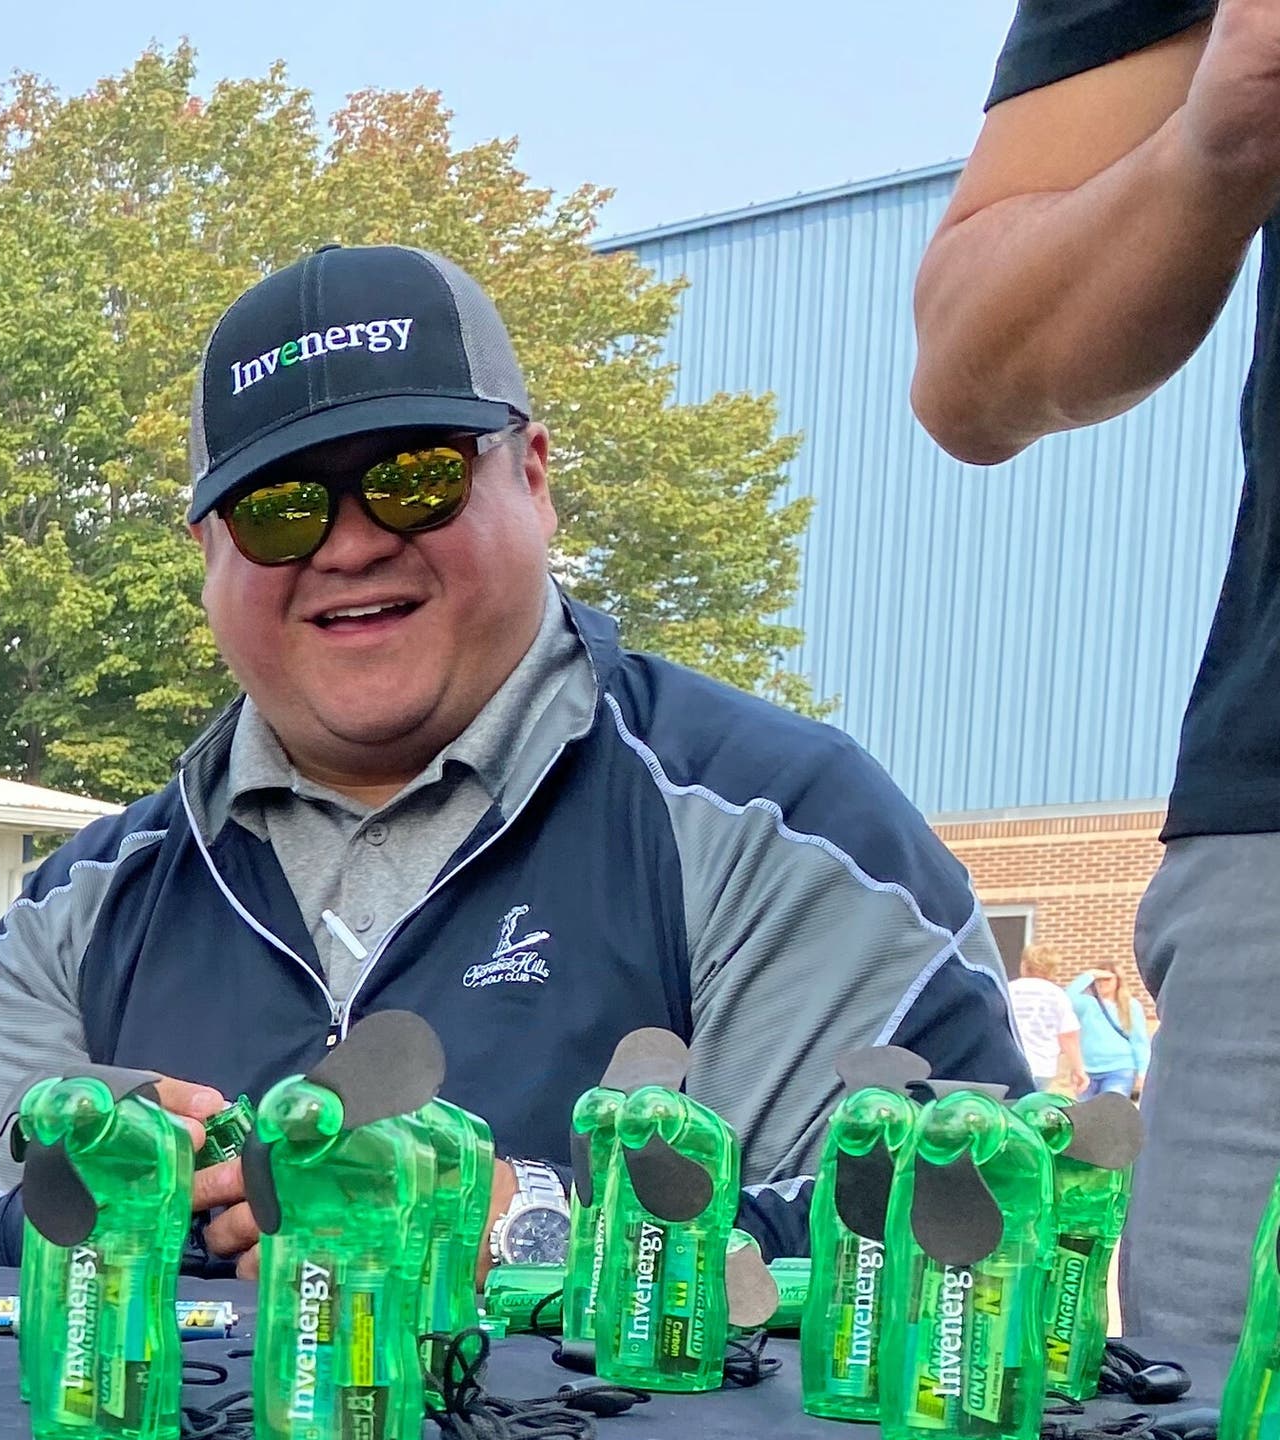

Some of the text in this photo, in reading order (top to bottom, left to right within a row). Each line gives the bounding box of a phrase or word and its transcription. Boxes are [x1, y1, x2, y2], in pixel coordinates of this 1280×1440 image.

[231, 318, 413, 396] Invenergy
[481, 972, 530, 986] GOLF CLUB
[512, 951, 551, 978] Hills
[60, 1246, 98, 1390] Invenergy
[627, 1220, 665, 1342] Invenergy
[845, 1237, 886, 1367] Invenergy
[932, 1265, 974, 1397] Invenerg
[1046, 1259, 1083, 1363] NANGRAND
[288, 1258, 331, 1421] Invenergy
[671, 1321, 683, 1357] Carbon
